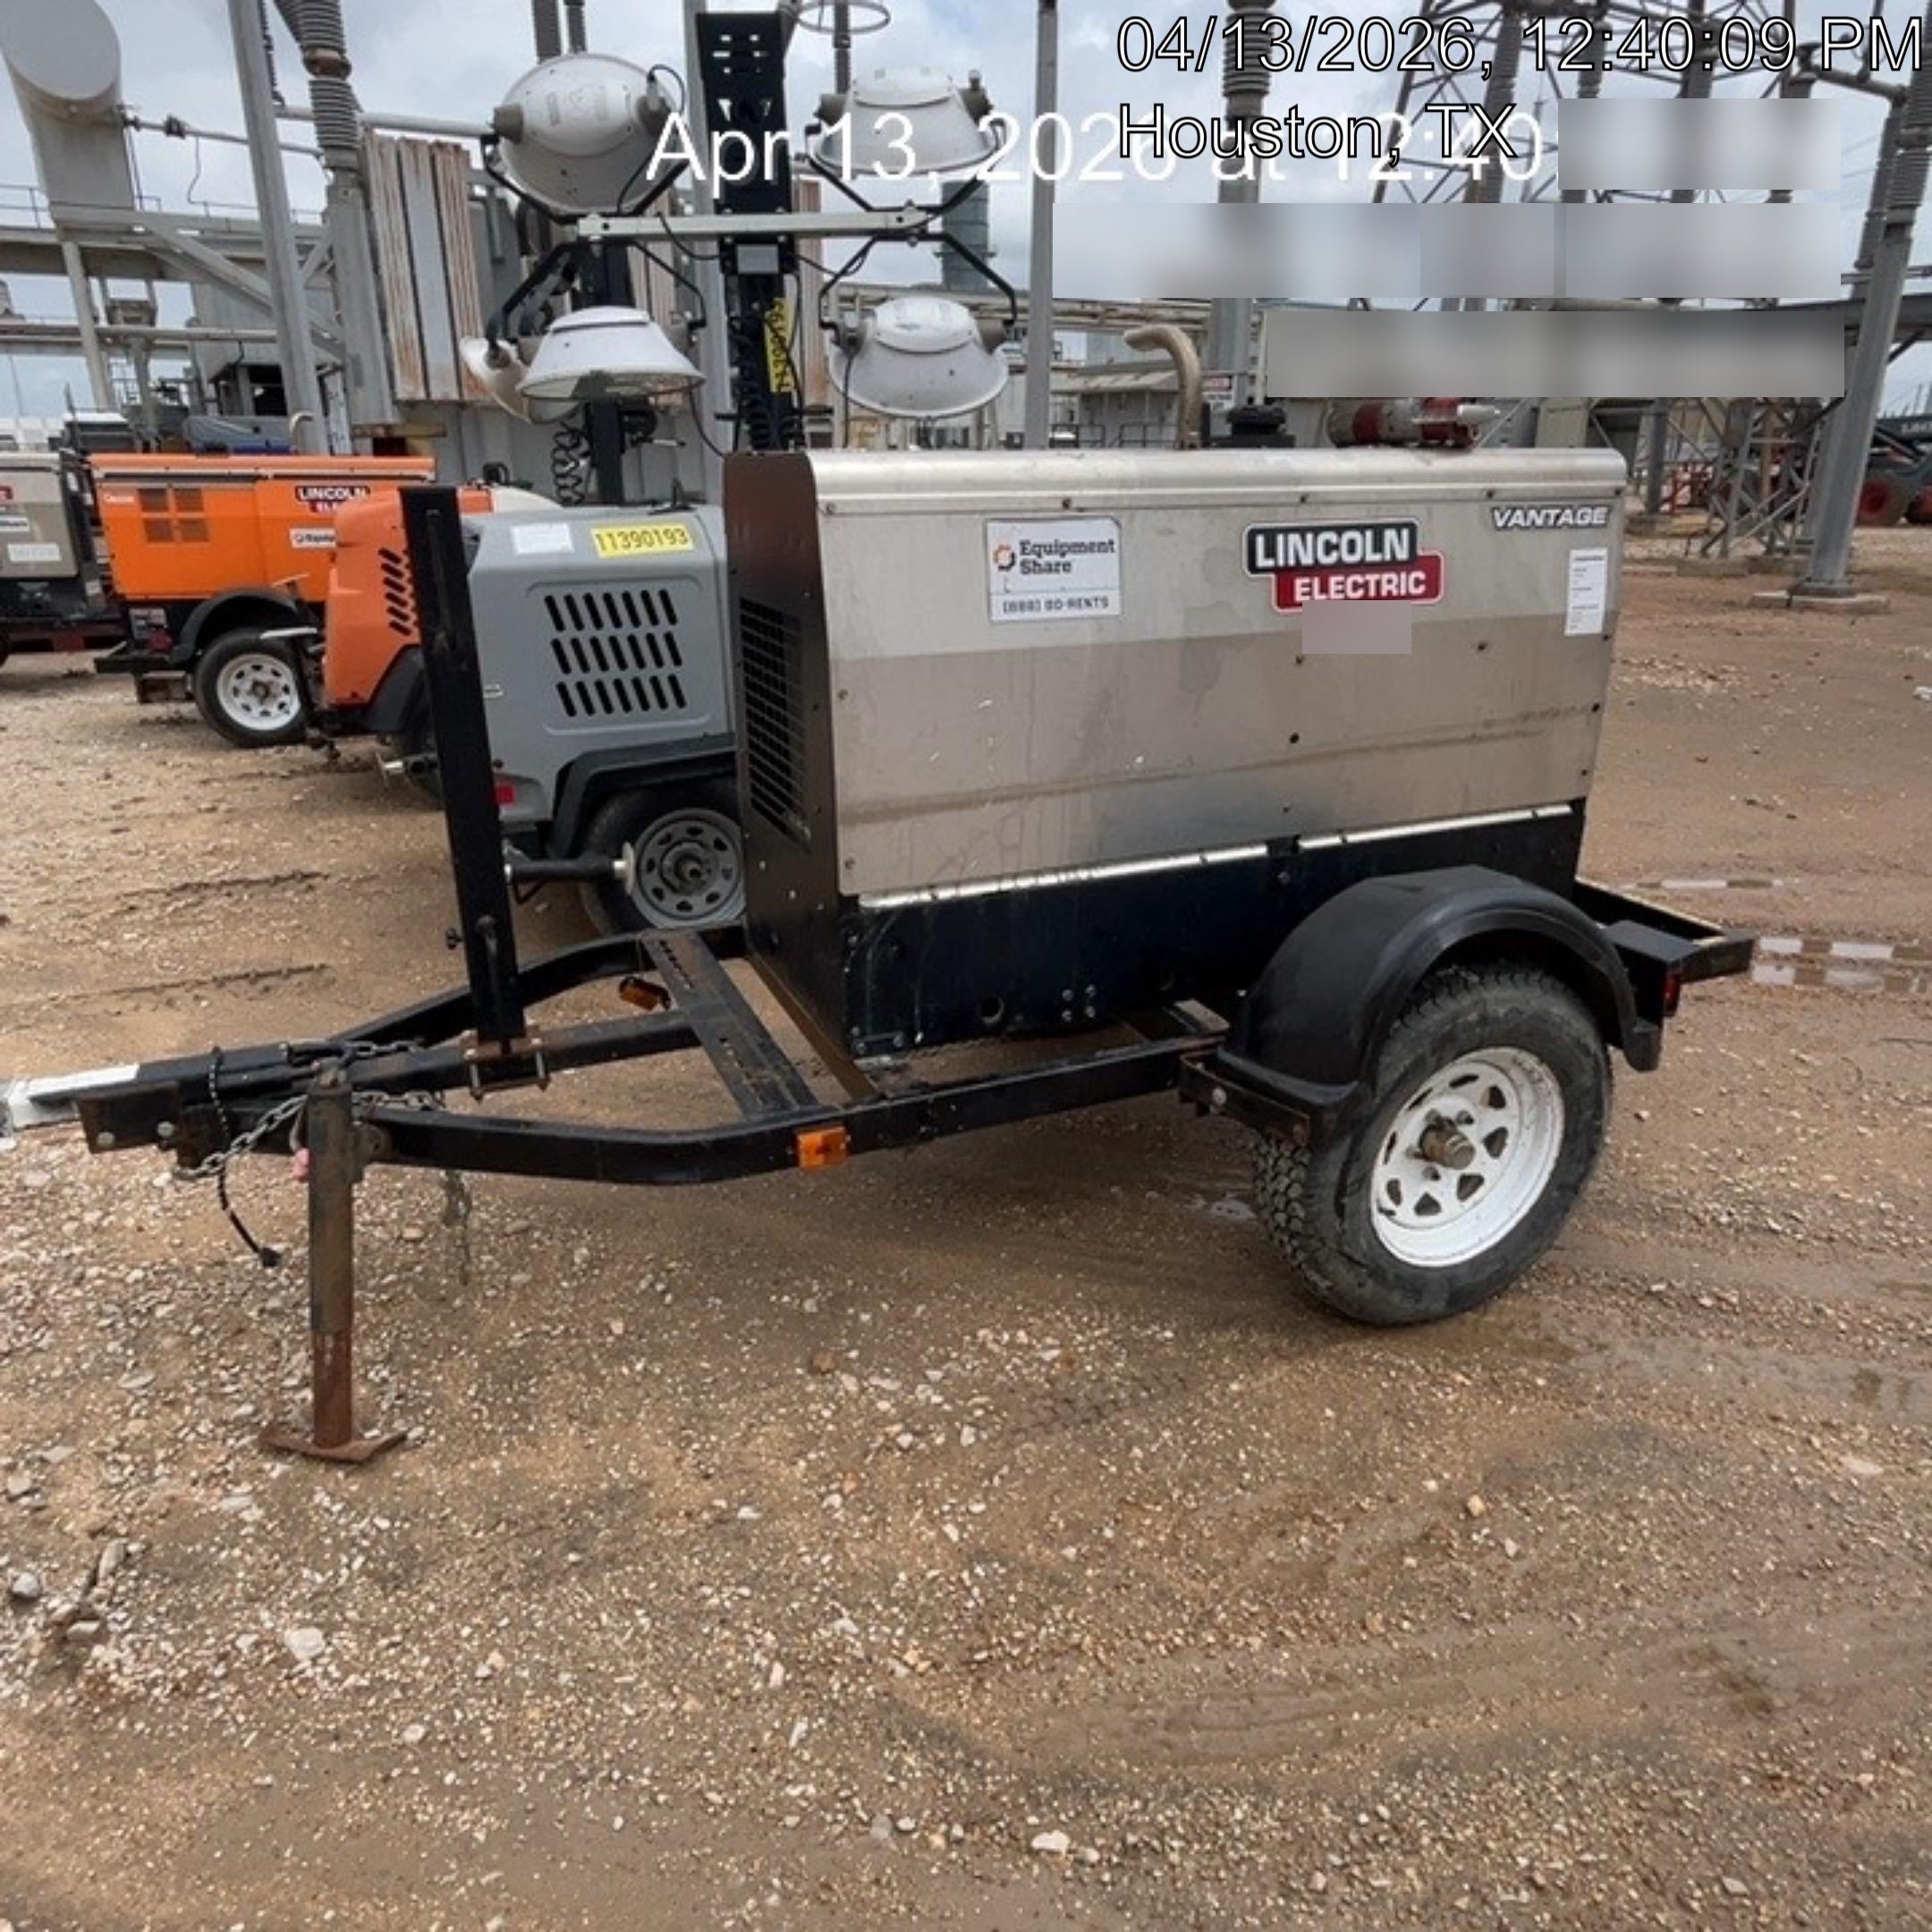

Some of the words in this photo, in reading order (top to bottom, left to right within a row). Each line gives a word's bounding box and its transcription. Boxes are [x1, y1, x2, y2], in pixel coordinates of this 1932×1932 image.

[1493, 506, 1609, 528] VANTAGE
[595, 529, 690, 551] 11390193
[1019, 539, 1116, 558] Equipment
[1255, 528, 1411, 568] LINCOLN
[1020, 558, 1072, 575] Share
[1295, 571, 1427, 601] ELECTRIC
